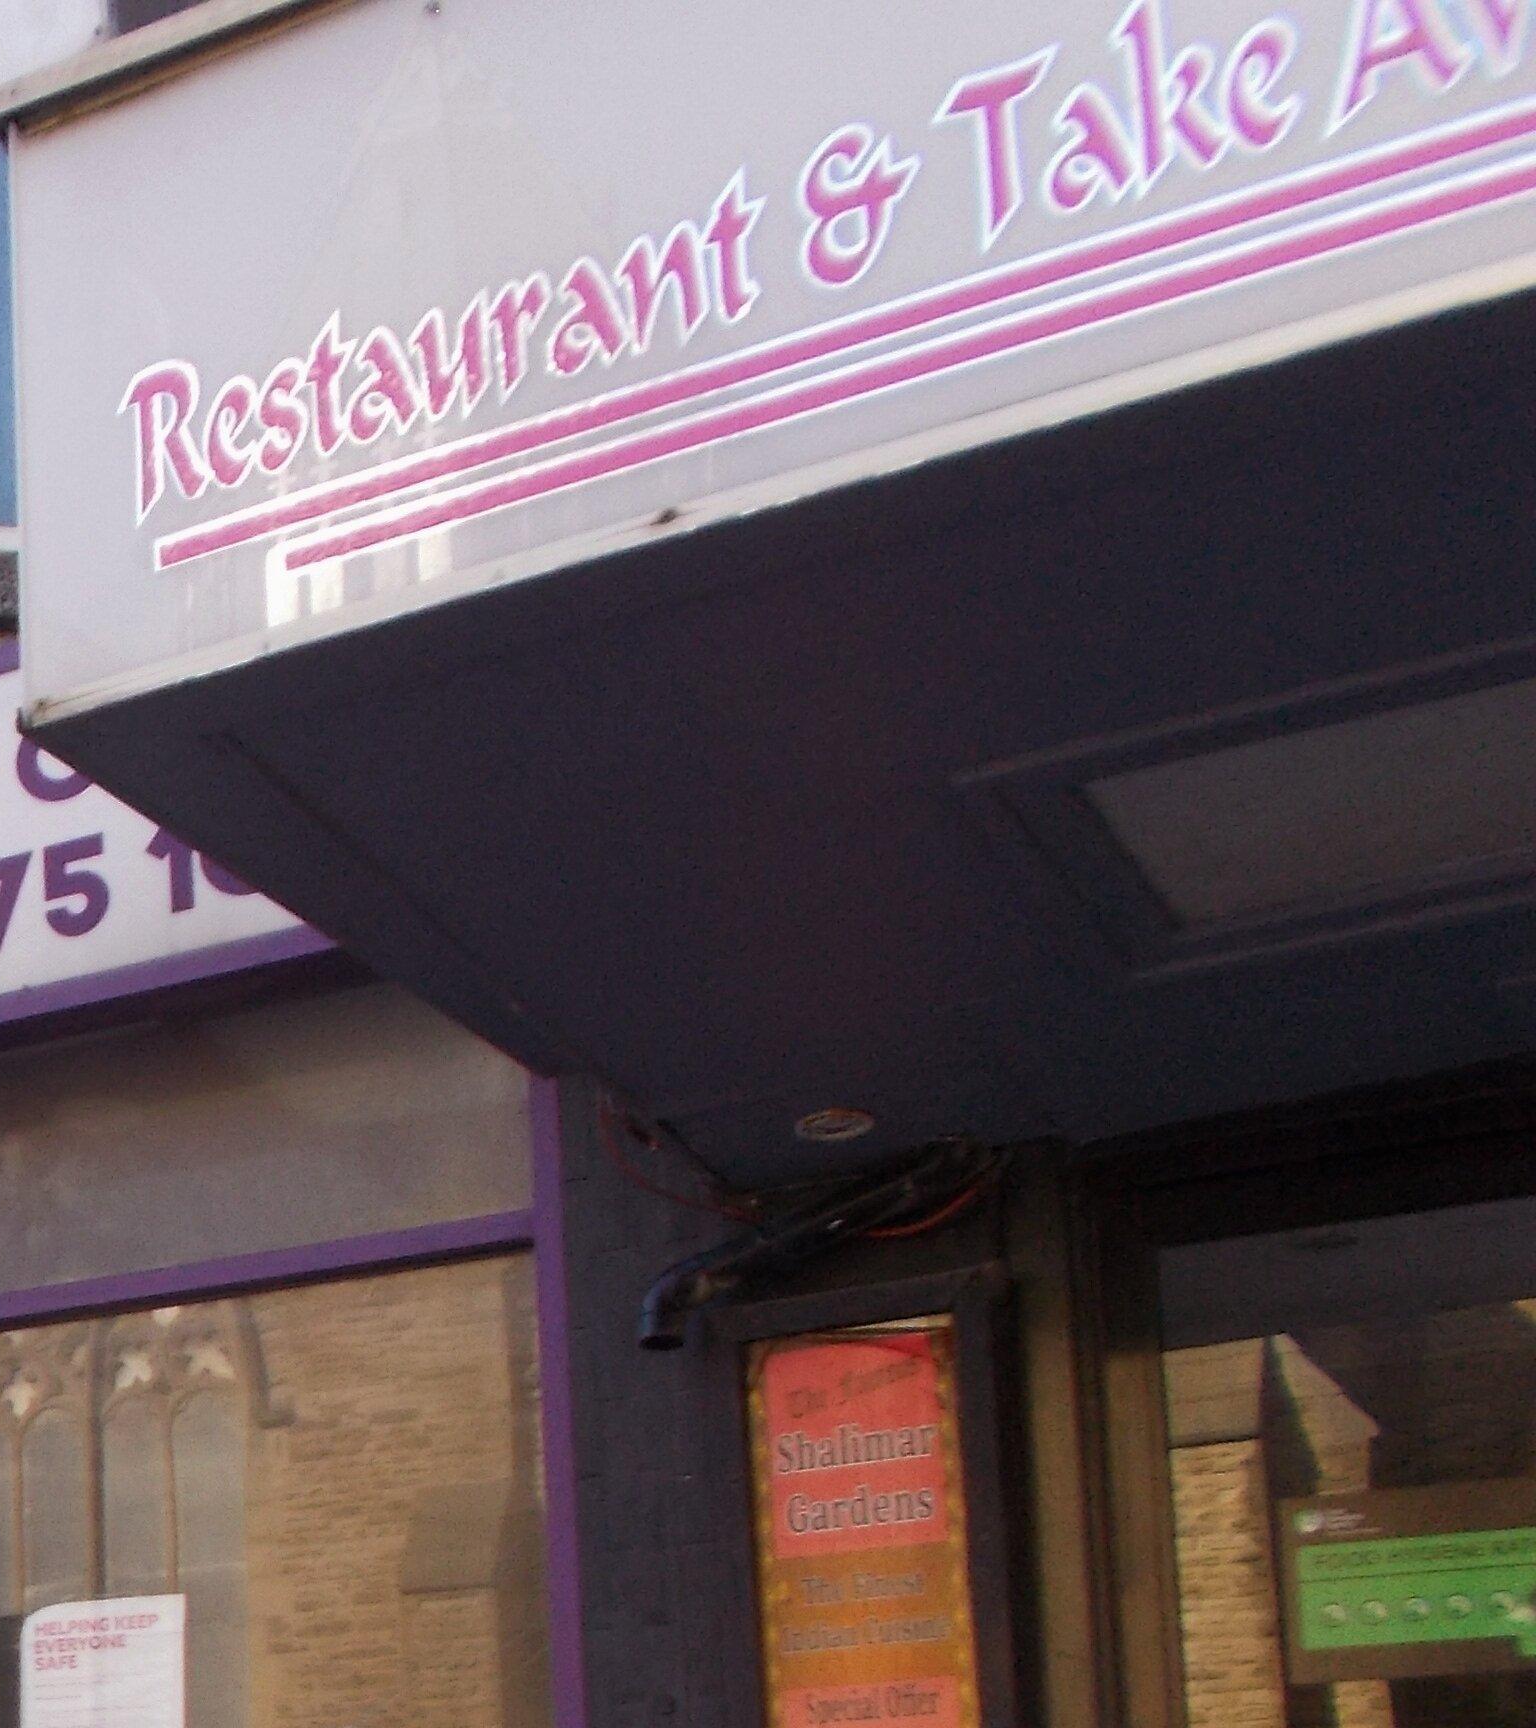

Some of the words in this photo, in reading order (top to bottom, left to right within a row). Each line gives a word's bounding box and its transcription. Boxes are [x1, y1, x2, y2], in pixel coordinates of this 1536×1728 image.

[117, 165, 766, 526] Restaurant
[798, 123, 921, 287] &
[932, 0, 1306, 254] Take
[1326, 0, 1536, 137] A
[778, 1423, 936, 1474] Shalimar
[786, 1484, 935, 1535] Gardens
